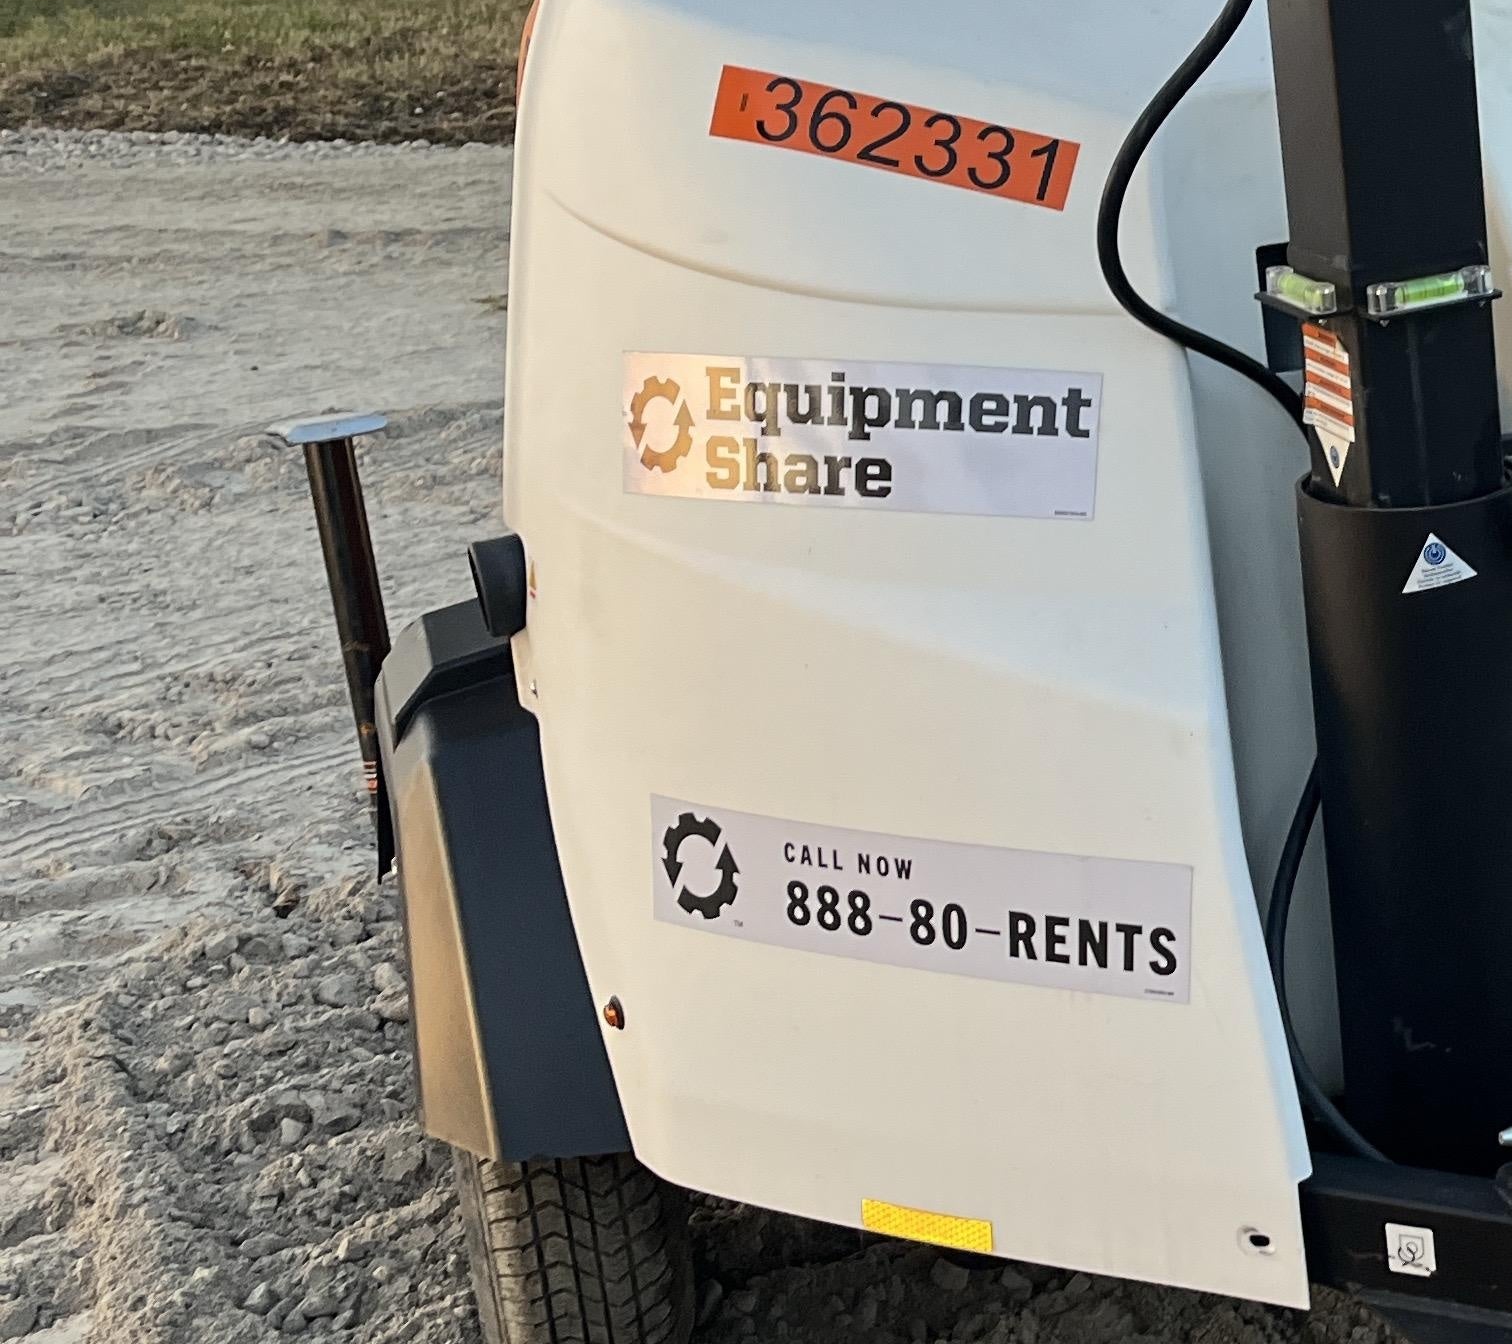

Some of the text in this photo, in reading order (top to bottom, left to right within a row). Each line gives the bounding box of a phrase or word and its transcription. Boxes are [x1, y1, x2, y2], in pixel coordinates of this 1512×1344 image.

[755, 76, 1060, 200] 362331
[705, 367, 1092, 440] Equipment
[705, 436, 892, 498] Share
[784, 842, 913, 880] CALL NOW
[786, 880, 1177, 975] 888-80-RENTS
